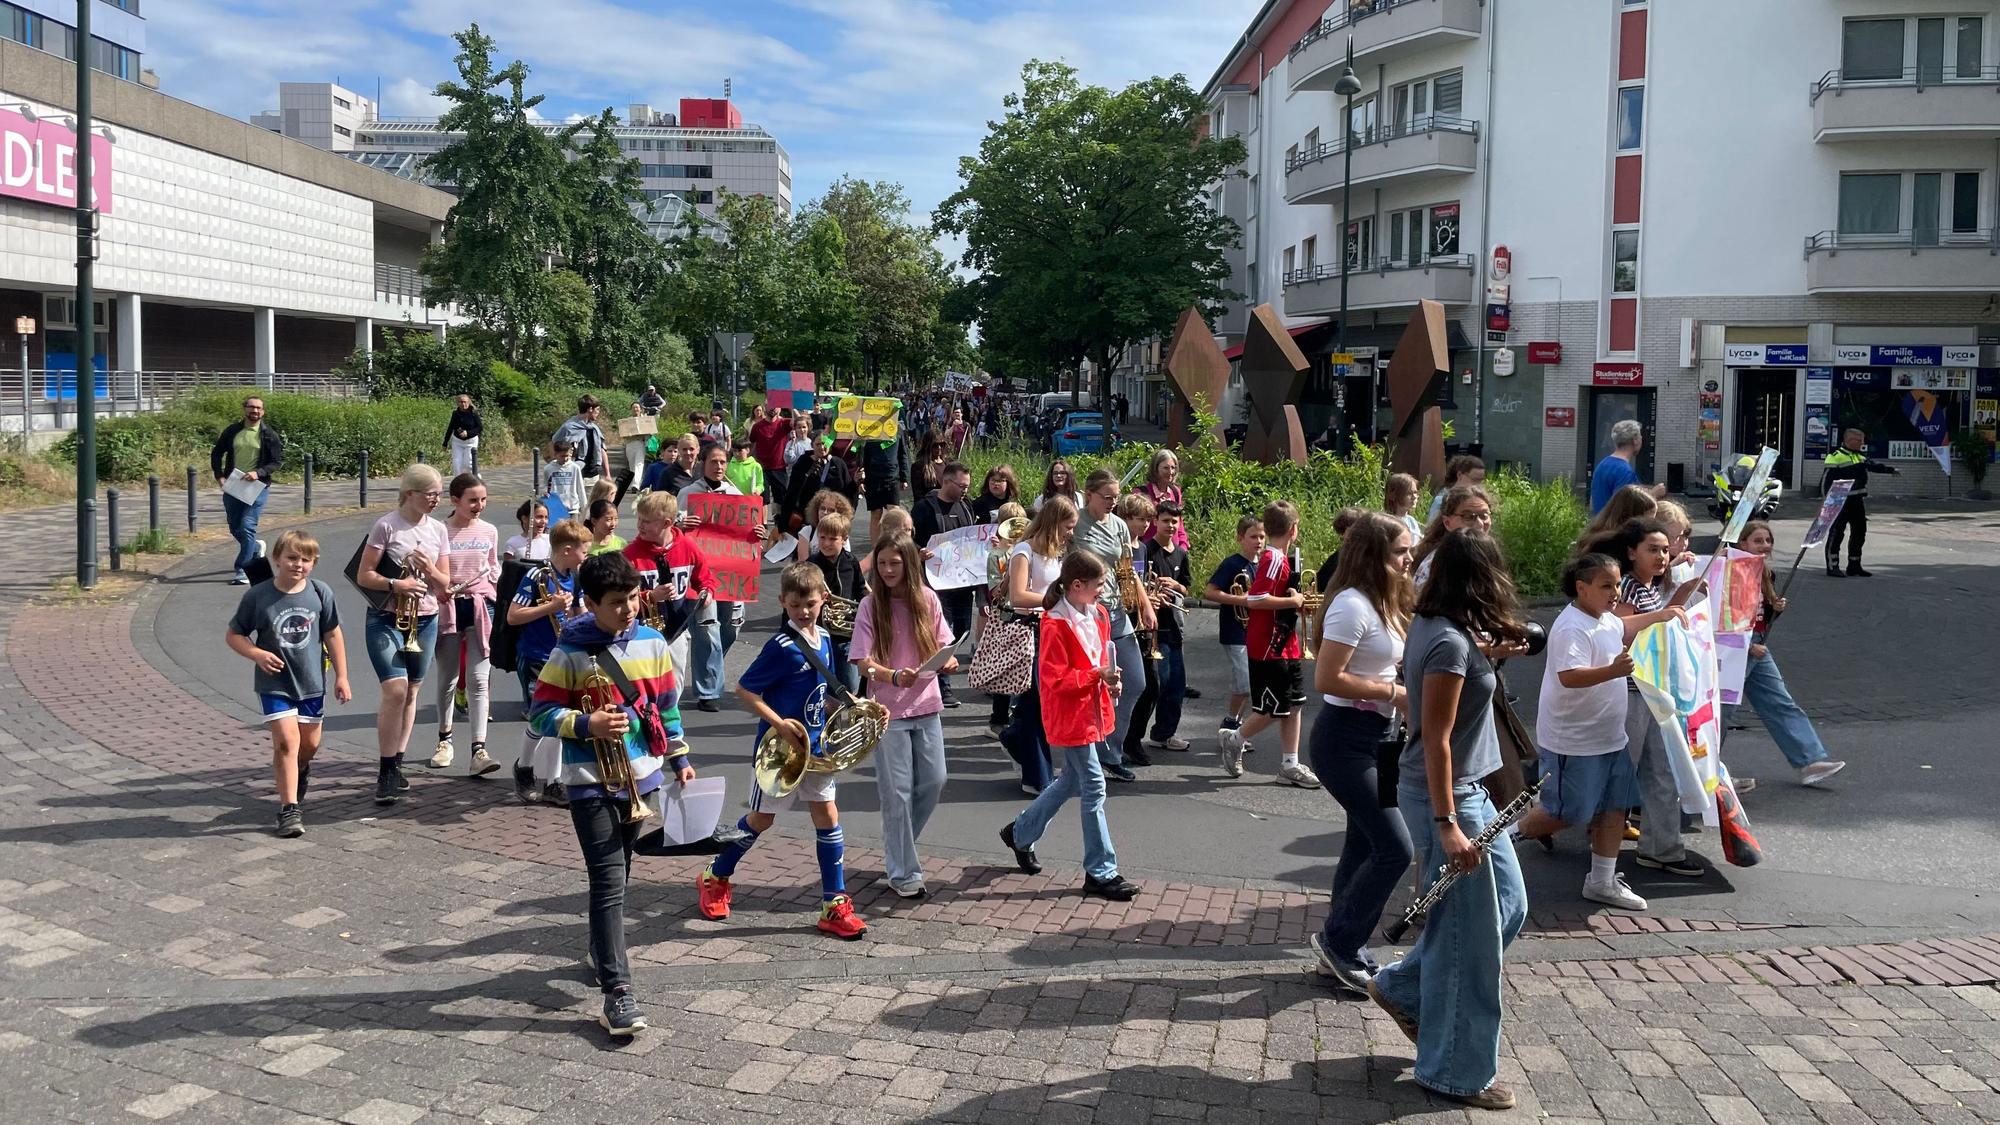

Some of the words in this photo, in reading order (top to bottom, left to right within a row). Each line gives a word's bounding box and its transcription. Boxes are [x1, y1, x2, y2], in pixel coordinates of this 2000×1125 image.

[0, 130, 98, 203] DLE
[1729, 349, 1752, 358] Lyca
[1838, 350, 1861, 359] Lyca
[1878, 347, 1913, 356] Familie
[1946, 350, 1969, 360] Lyca
[1843, 370, 1871, 381] Lyca
[1919, 424, 1940, 433] VEEV
[640, 571, 689, 596] NC
[282, 626, 308, 634] NASA
